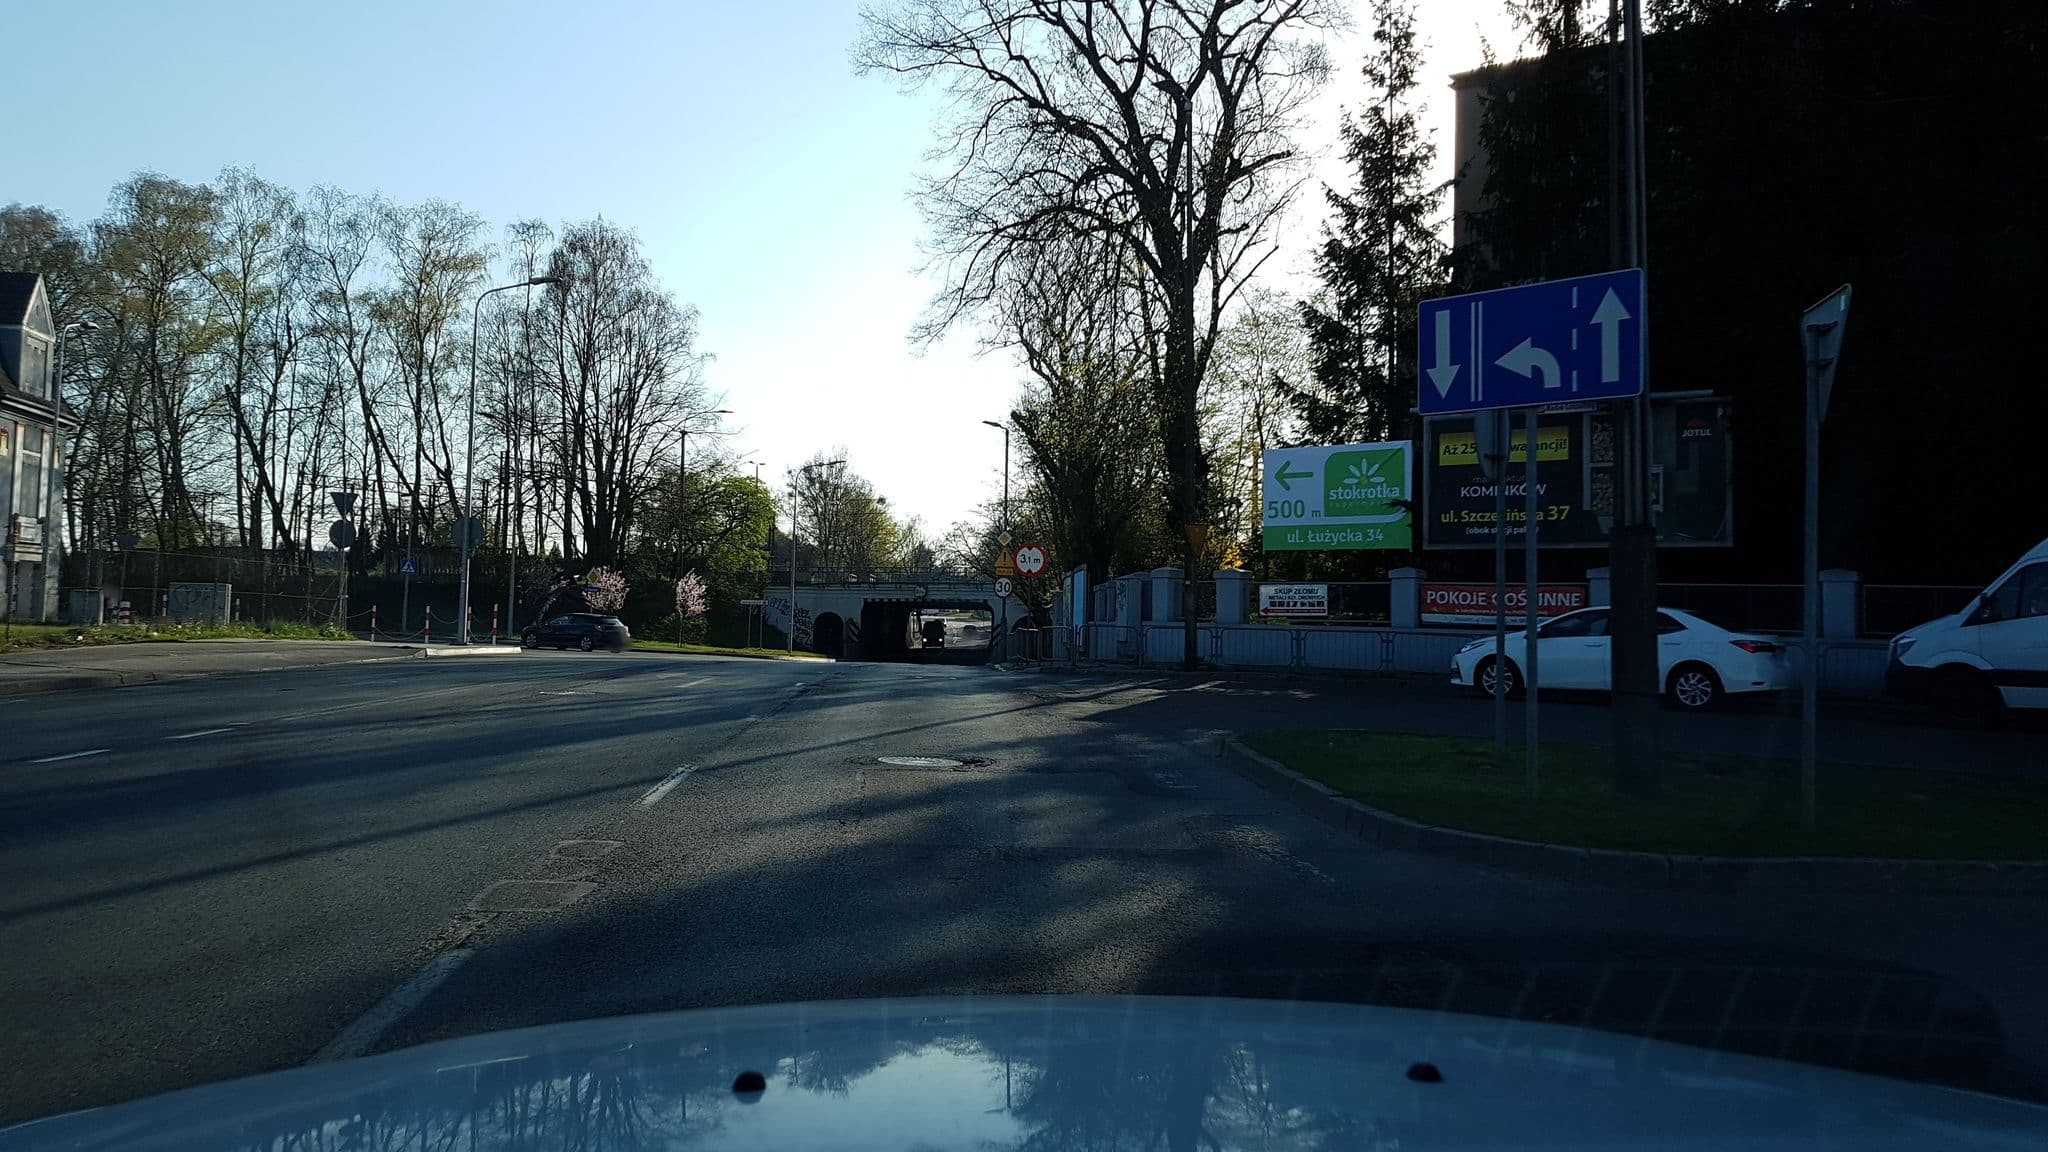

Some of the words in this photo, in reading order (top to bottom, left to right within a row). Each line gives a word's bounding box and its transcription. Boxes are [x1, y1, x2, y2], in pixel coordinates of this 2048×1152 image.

[1443, 444, 1458, 455] Aż
[1460, 442, 1477, 454] 25
[1329, 483, 1400, 500] stokrotka
[1460, 482, 1548, 498] KOMIKÓW
[1267, 500, 1305, 519] 500
[1311, 510, 1321, 518] m
[1440, 510, 1458, 523] ul.
[1460, 508, 1544, 523] Szczeińsa
[1547, 505, 1571, 521] 37
[1287, 531, 1304, 543] ul.
[1307, 529, 1363, 546] Łużycka
[1367, 528, 1384, 542] 34
[997, 581, 1011, 593] 30
[1426, 590, 1487, 606] POKOJE
